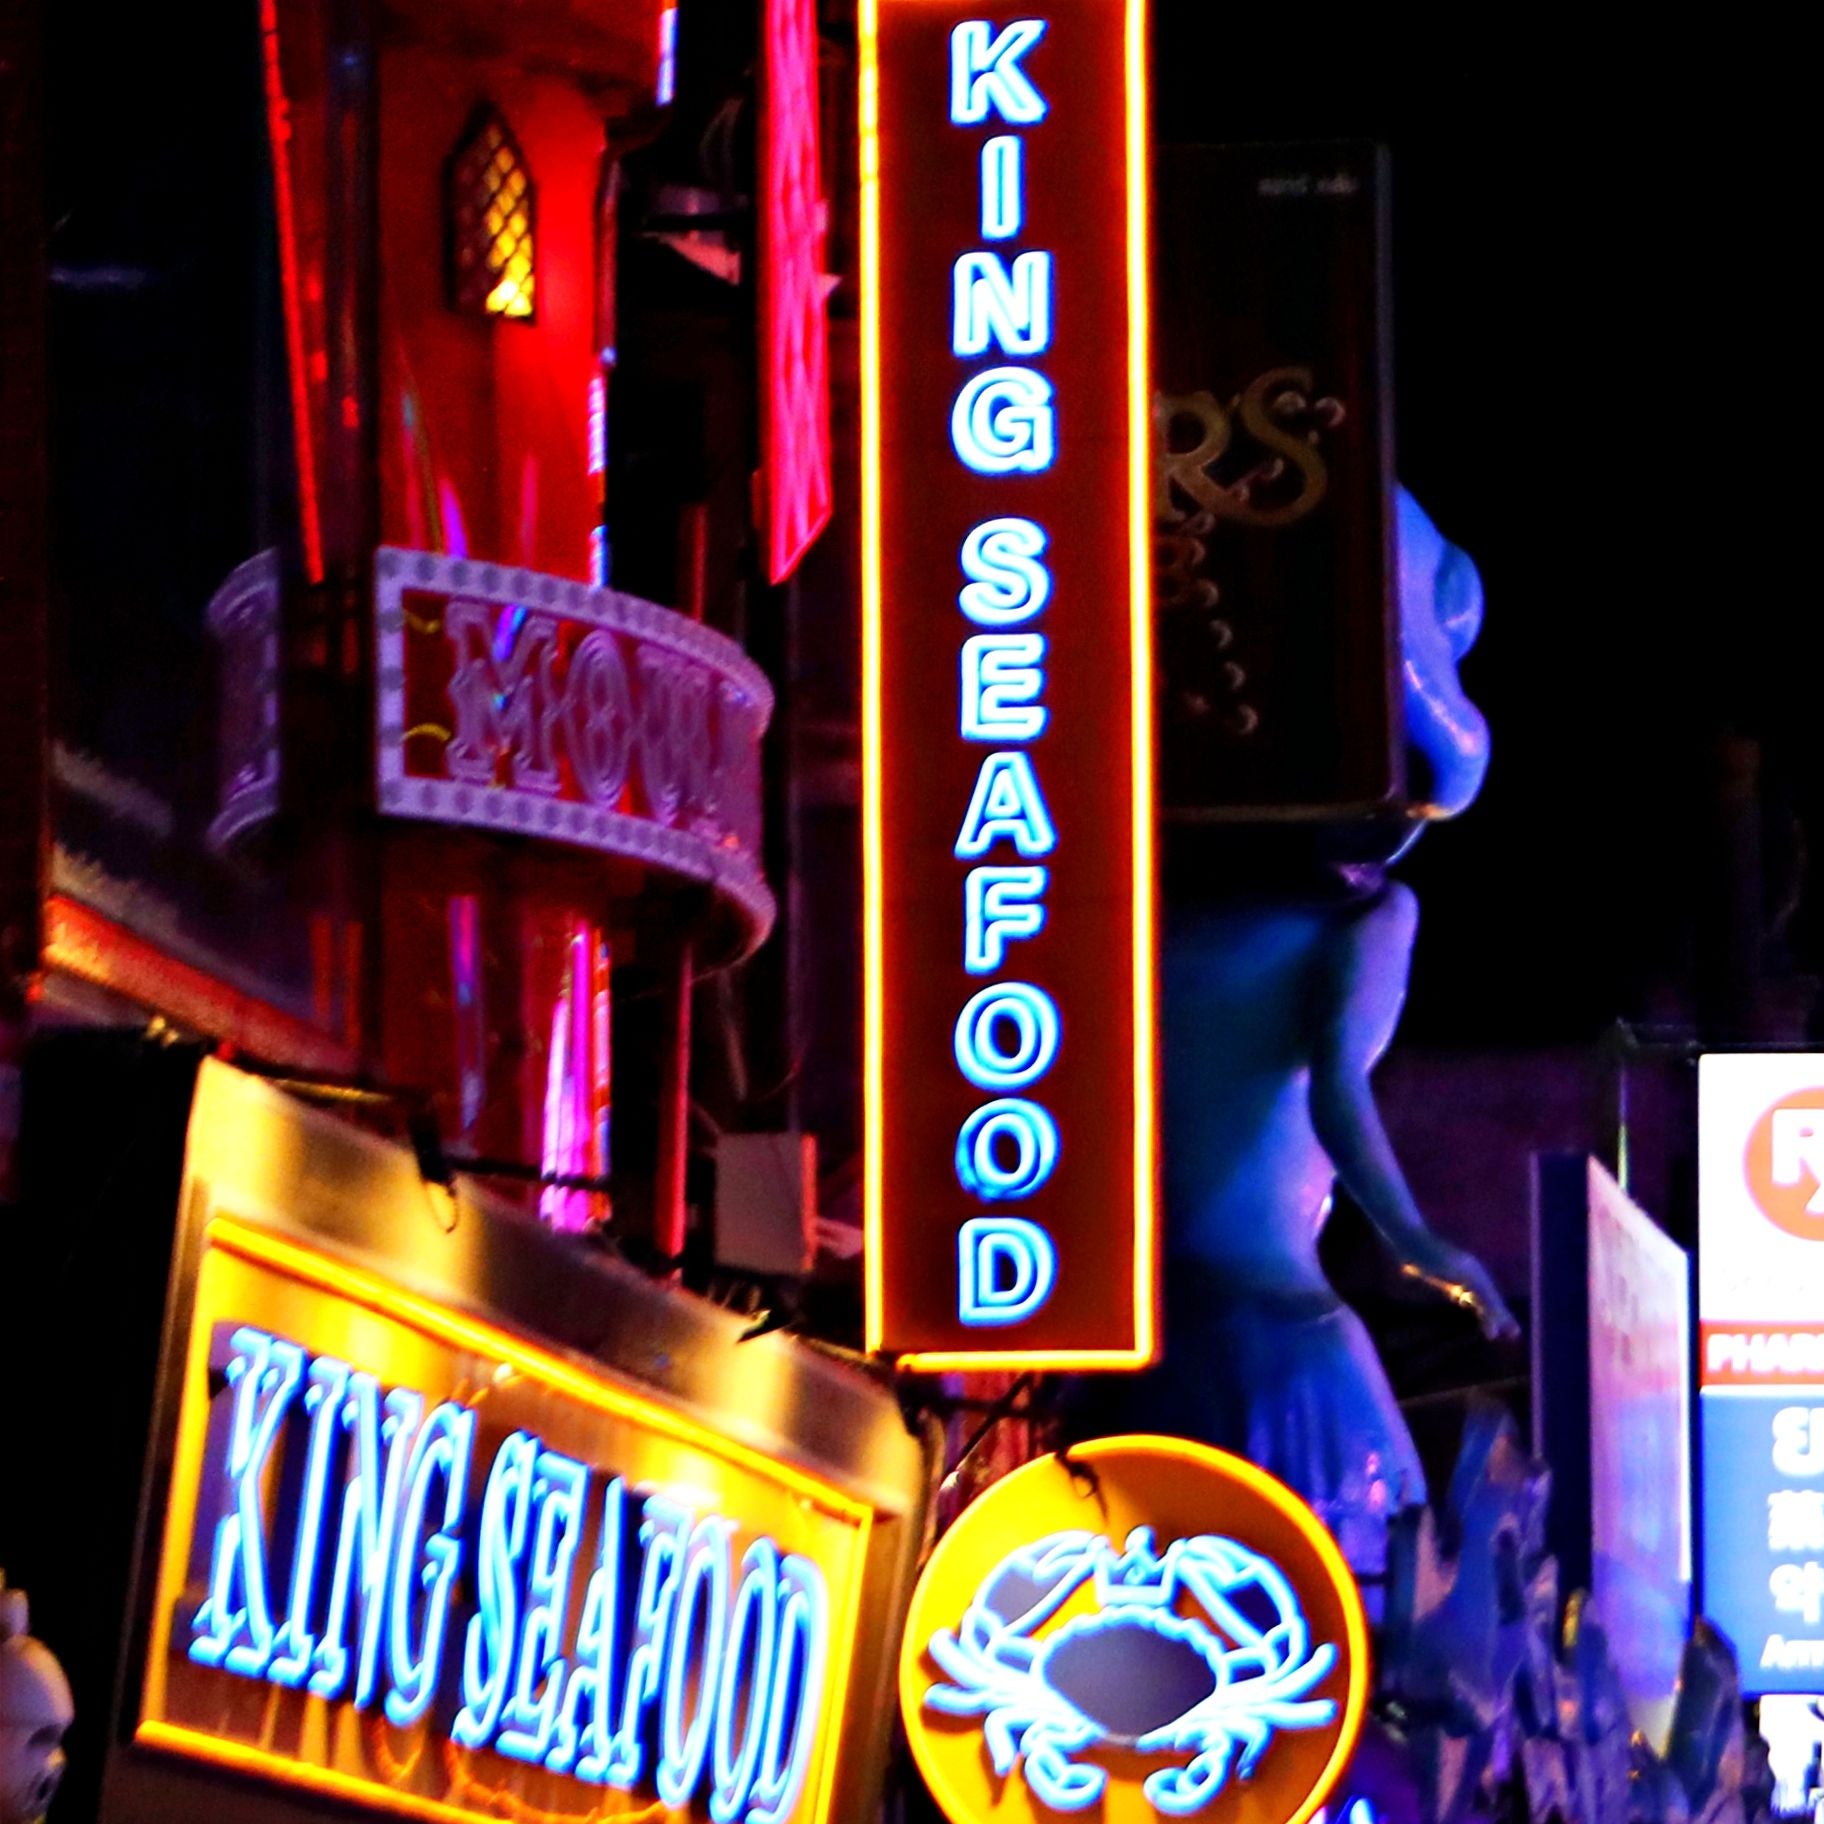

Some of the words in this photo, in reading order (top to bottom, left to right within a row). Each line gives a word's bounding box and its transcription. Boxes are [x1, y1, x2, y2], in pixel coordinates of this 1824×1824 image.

[950, 19, 1055, 476] KING
[954, 517, 1060, 1328] SEAFOOD
[189, 1324, 477, 1727] KING
